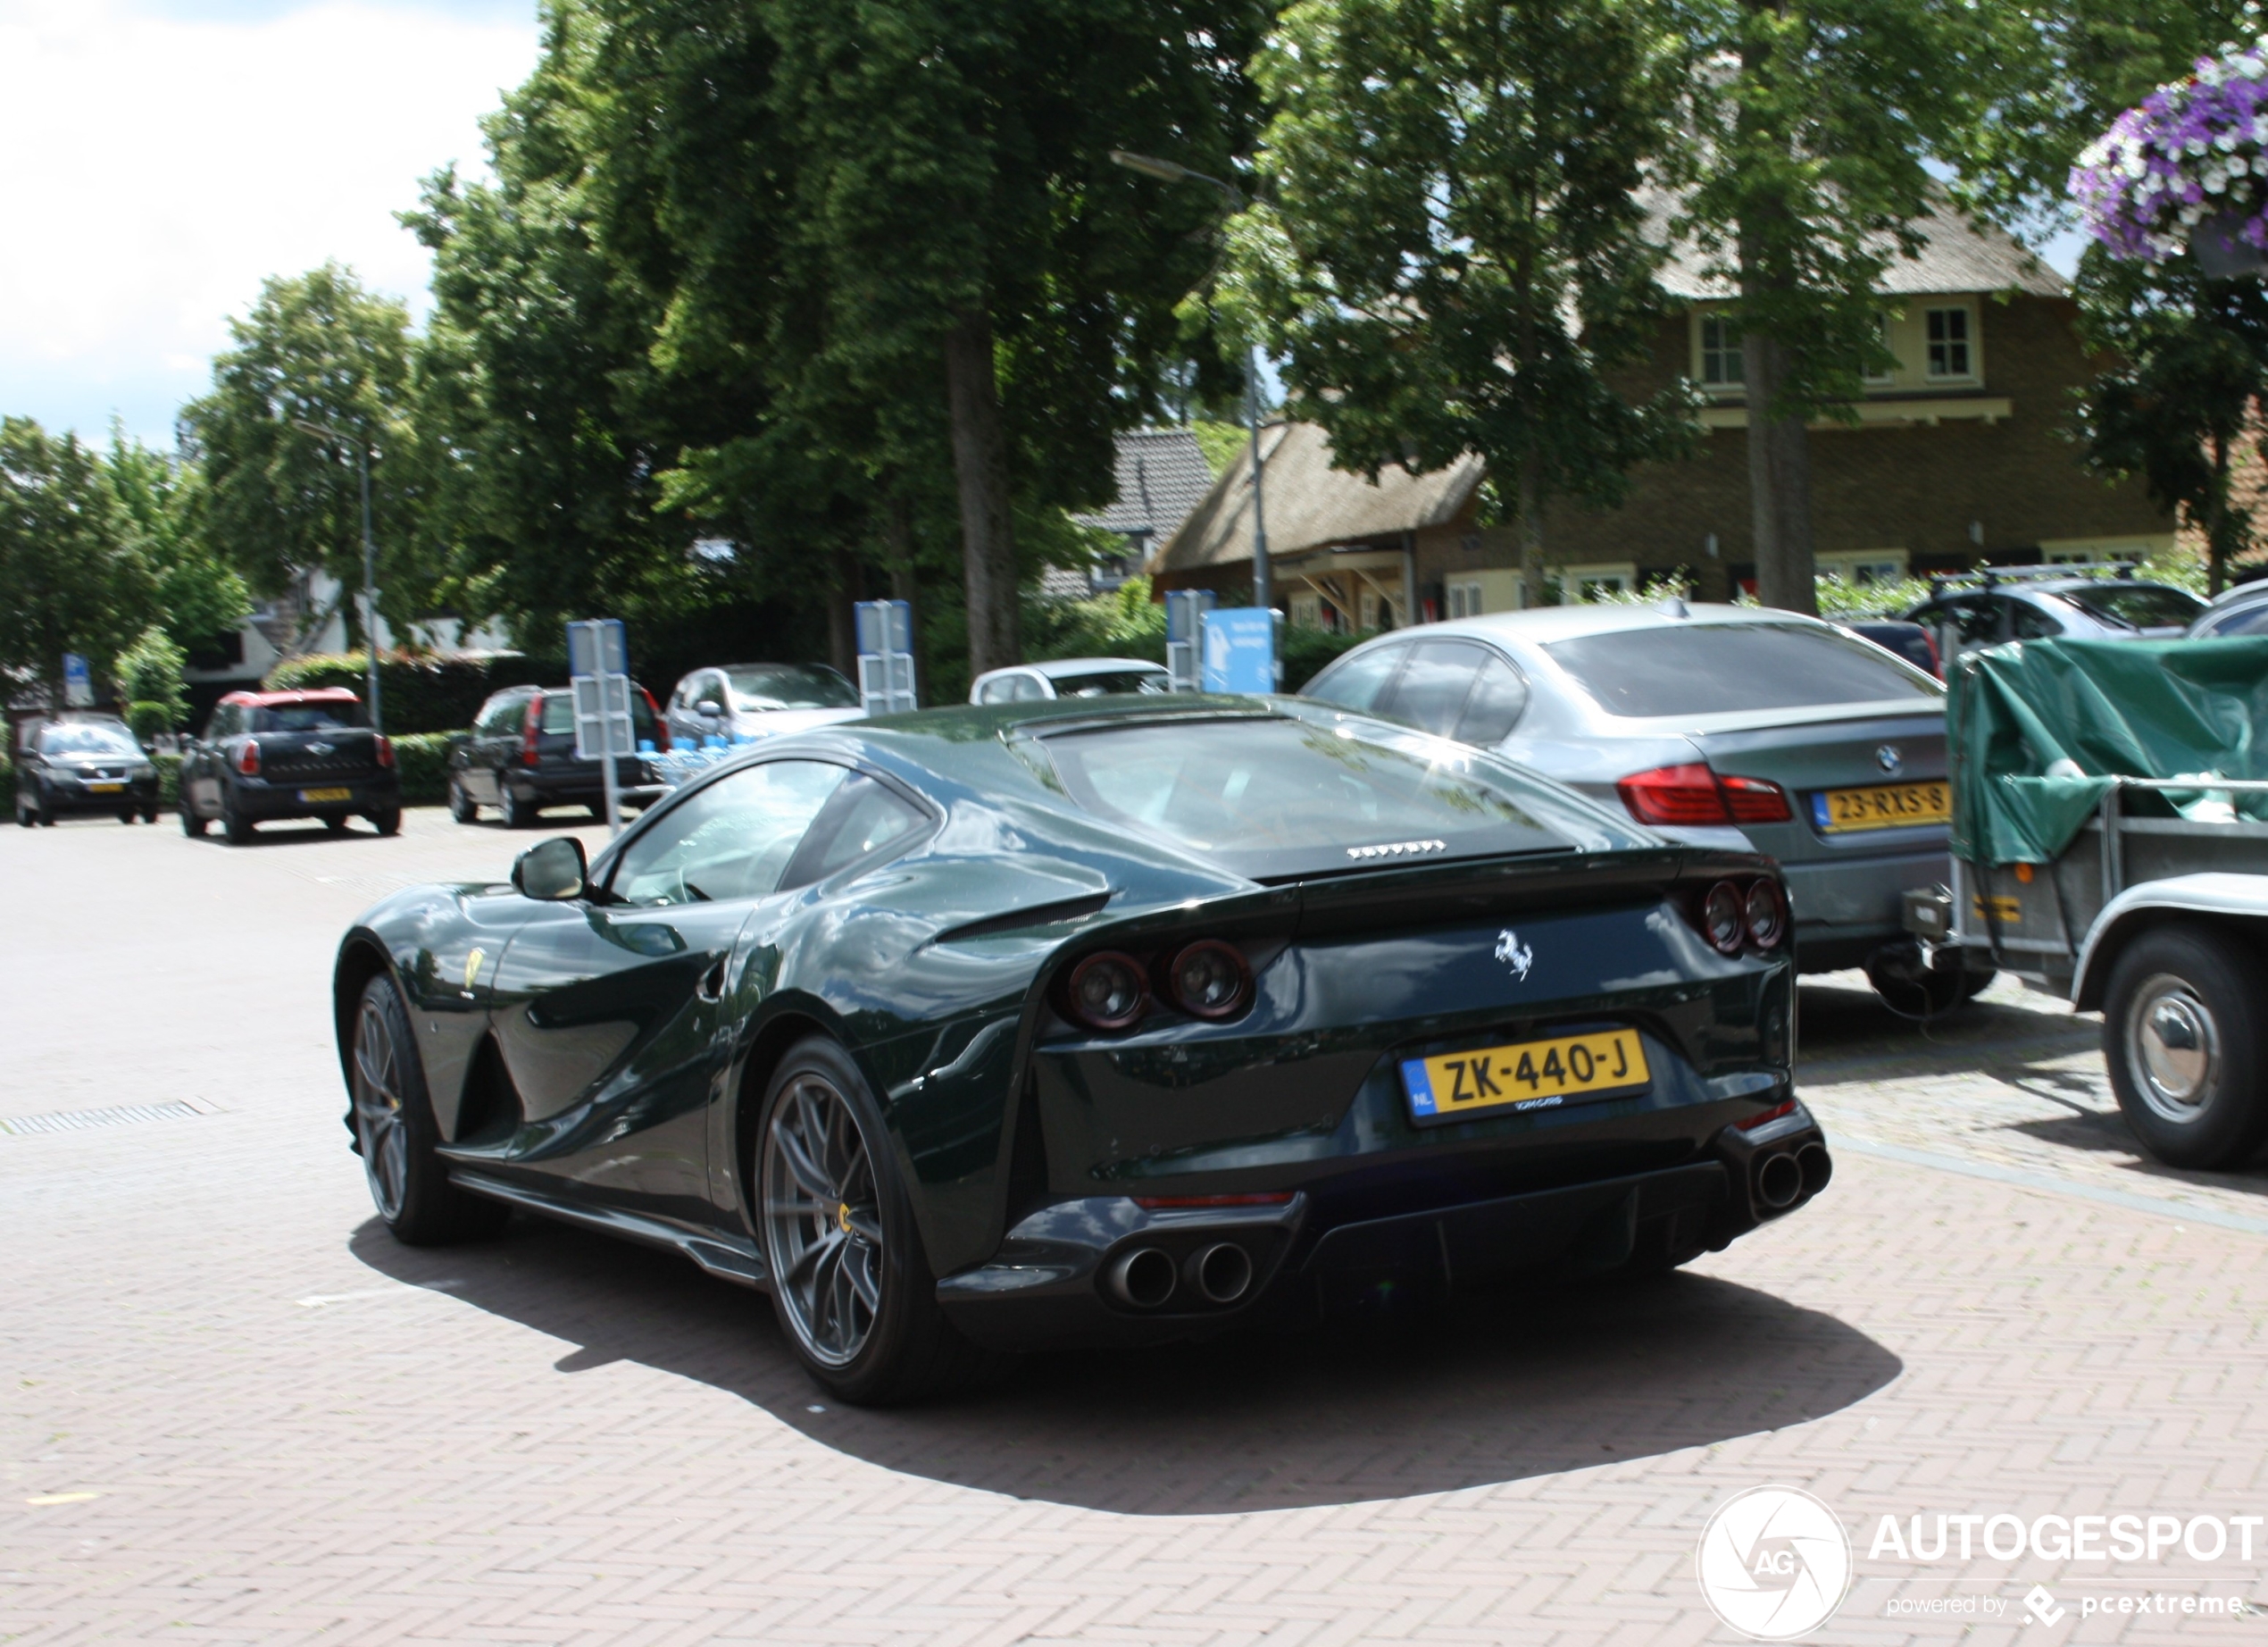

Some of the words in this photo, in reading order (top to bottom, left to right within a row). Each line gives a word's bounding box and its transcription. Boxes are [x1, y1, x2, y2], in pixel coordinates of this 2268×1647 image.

[1834, 787, 1945, 819] 23-RXS-8
[1445, 1039, 1629, 1102] ZK-440-J
[1413, 1091, 1432, 1108] NL
